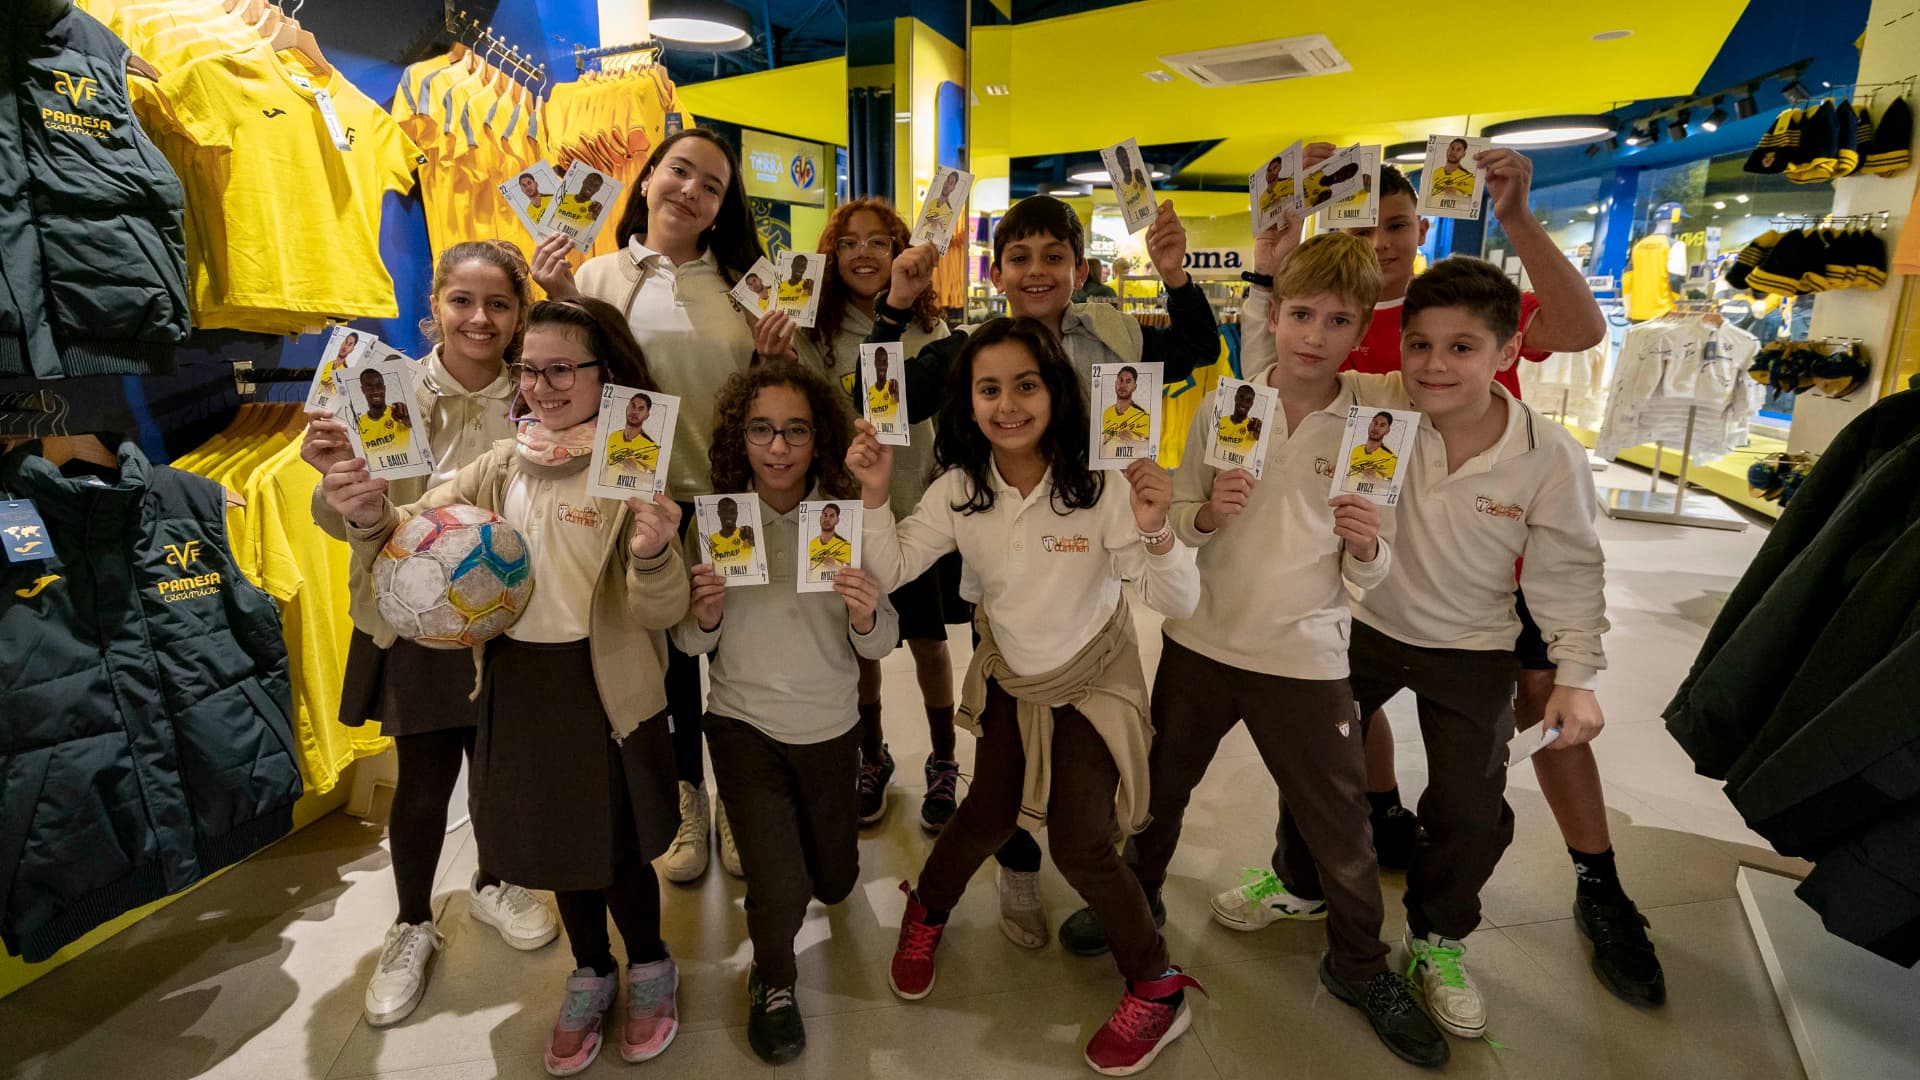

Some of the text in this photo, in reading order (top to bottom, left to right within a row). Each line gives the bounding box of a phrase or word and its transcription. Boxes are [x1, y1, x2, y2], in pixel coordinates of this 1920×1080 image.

[52, 70, 97, 106] CVF
[42, 108, 111, 131] PAMESA
[1440, 198, 1457, 209] AYOZE
[1182, 251, 1242, 268] oma
[1092, 366, 1101, 378] 22
[604, 386, 614, 398] 22
[1348, 408, 1358, 418] 22
[1116, 446, 1134, 458] AYOZE
[387, 452, 409, 467] BAILLY
[617, 474, 637, 488] AYOZE
[1356, 482, 1375, 493] AYOZE
[1387, 494, 1397, 504] 22
[800, 504, 808, 514] 22
[163, 540, 200, 571] CVF
[730, 564, 748, 576] BAILLY
[157, 572, 221, 595] PAMESA
